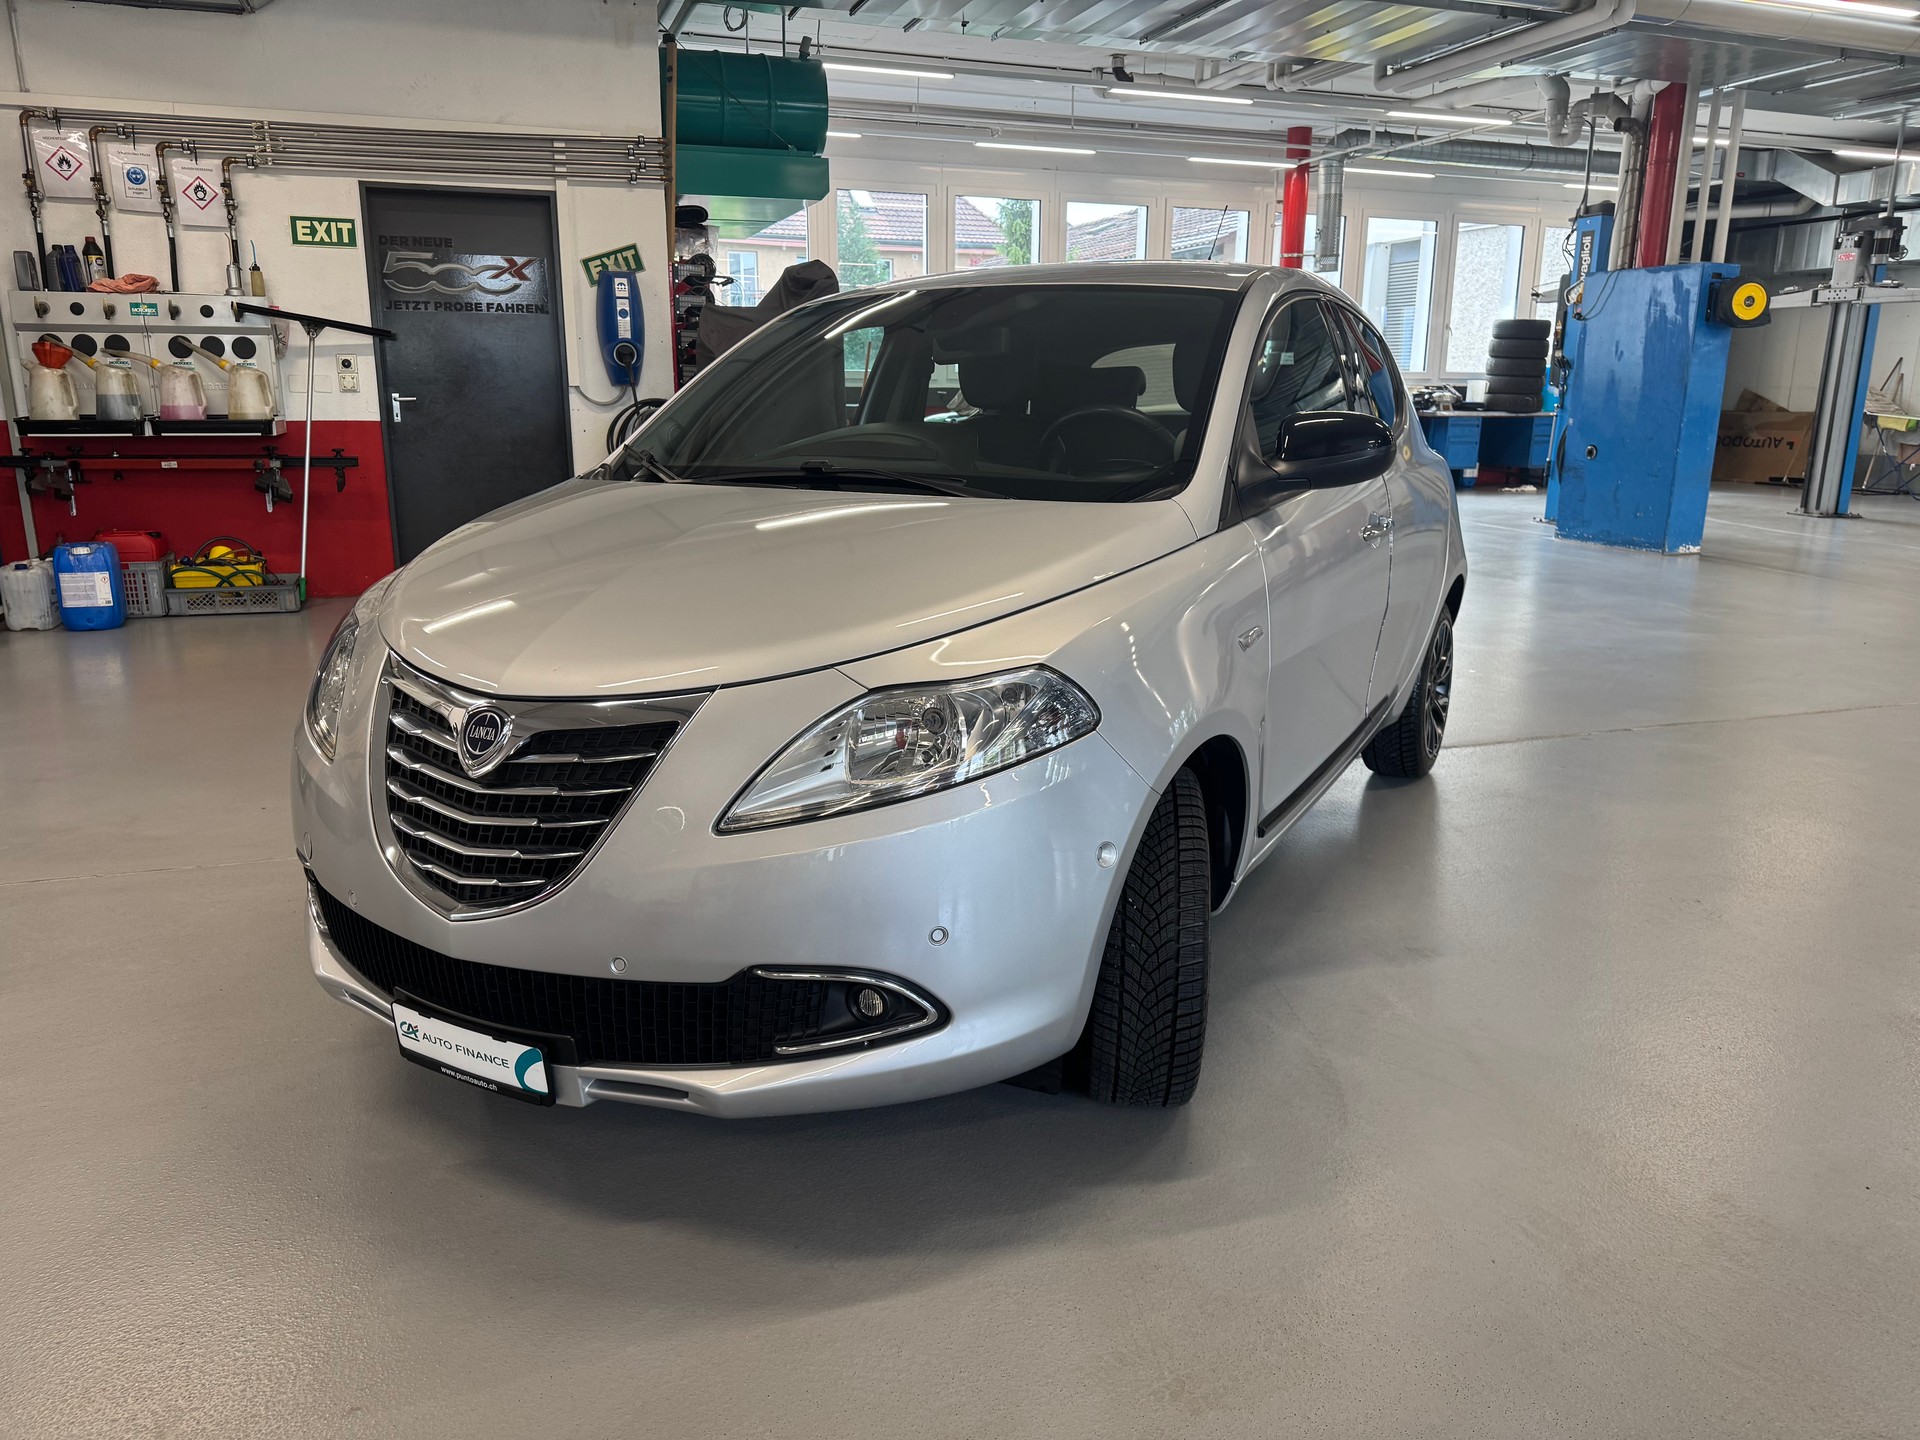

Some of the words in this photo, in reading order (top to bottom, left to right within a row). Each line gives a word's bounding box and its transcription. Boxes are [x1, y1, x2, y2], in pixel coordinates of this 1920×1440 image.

[296, 220, 352, 243] EXIT
[378, 235, 408, 247] DER
[412, 236, 453, 248] NEUE
[587, 249, 636, 280] EXIT
[385, 300, 431, 311] JETZT
[434, 301, 483, 312] PROBE
[1717, 435, 1784, 449] AUTODO
[469, 724, 496, 741] LANCIA
[422, 1032, 453, 1050] AUTO
[455, 1043, 510, 1069] FINANCE
[440, 1066, 498, 1092] www.puntoauto.ch
